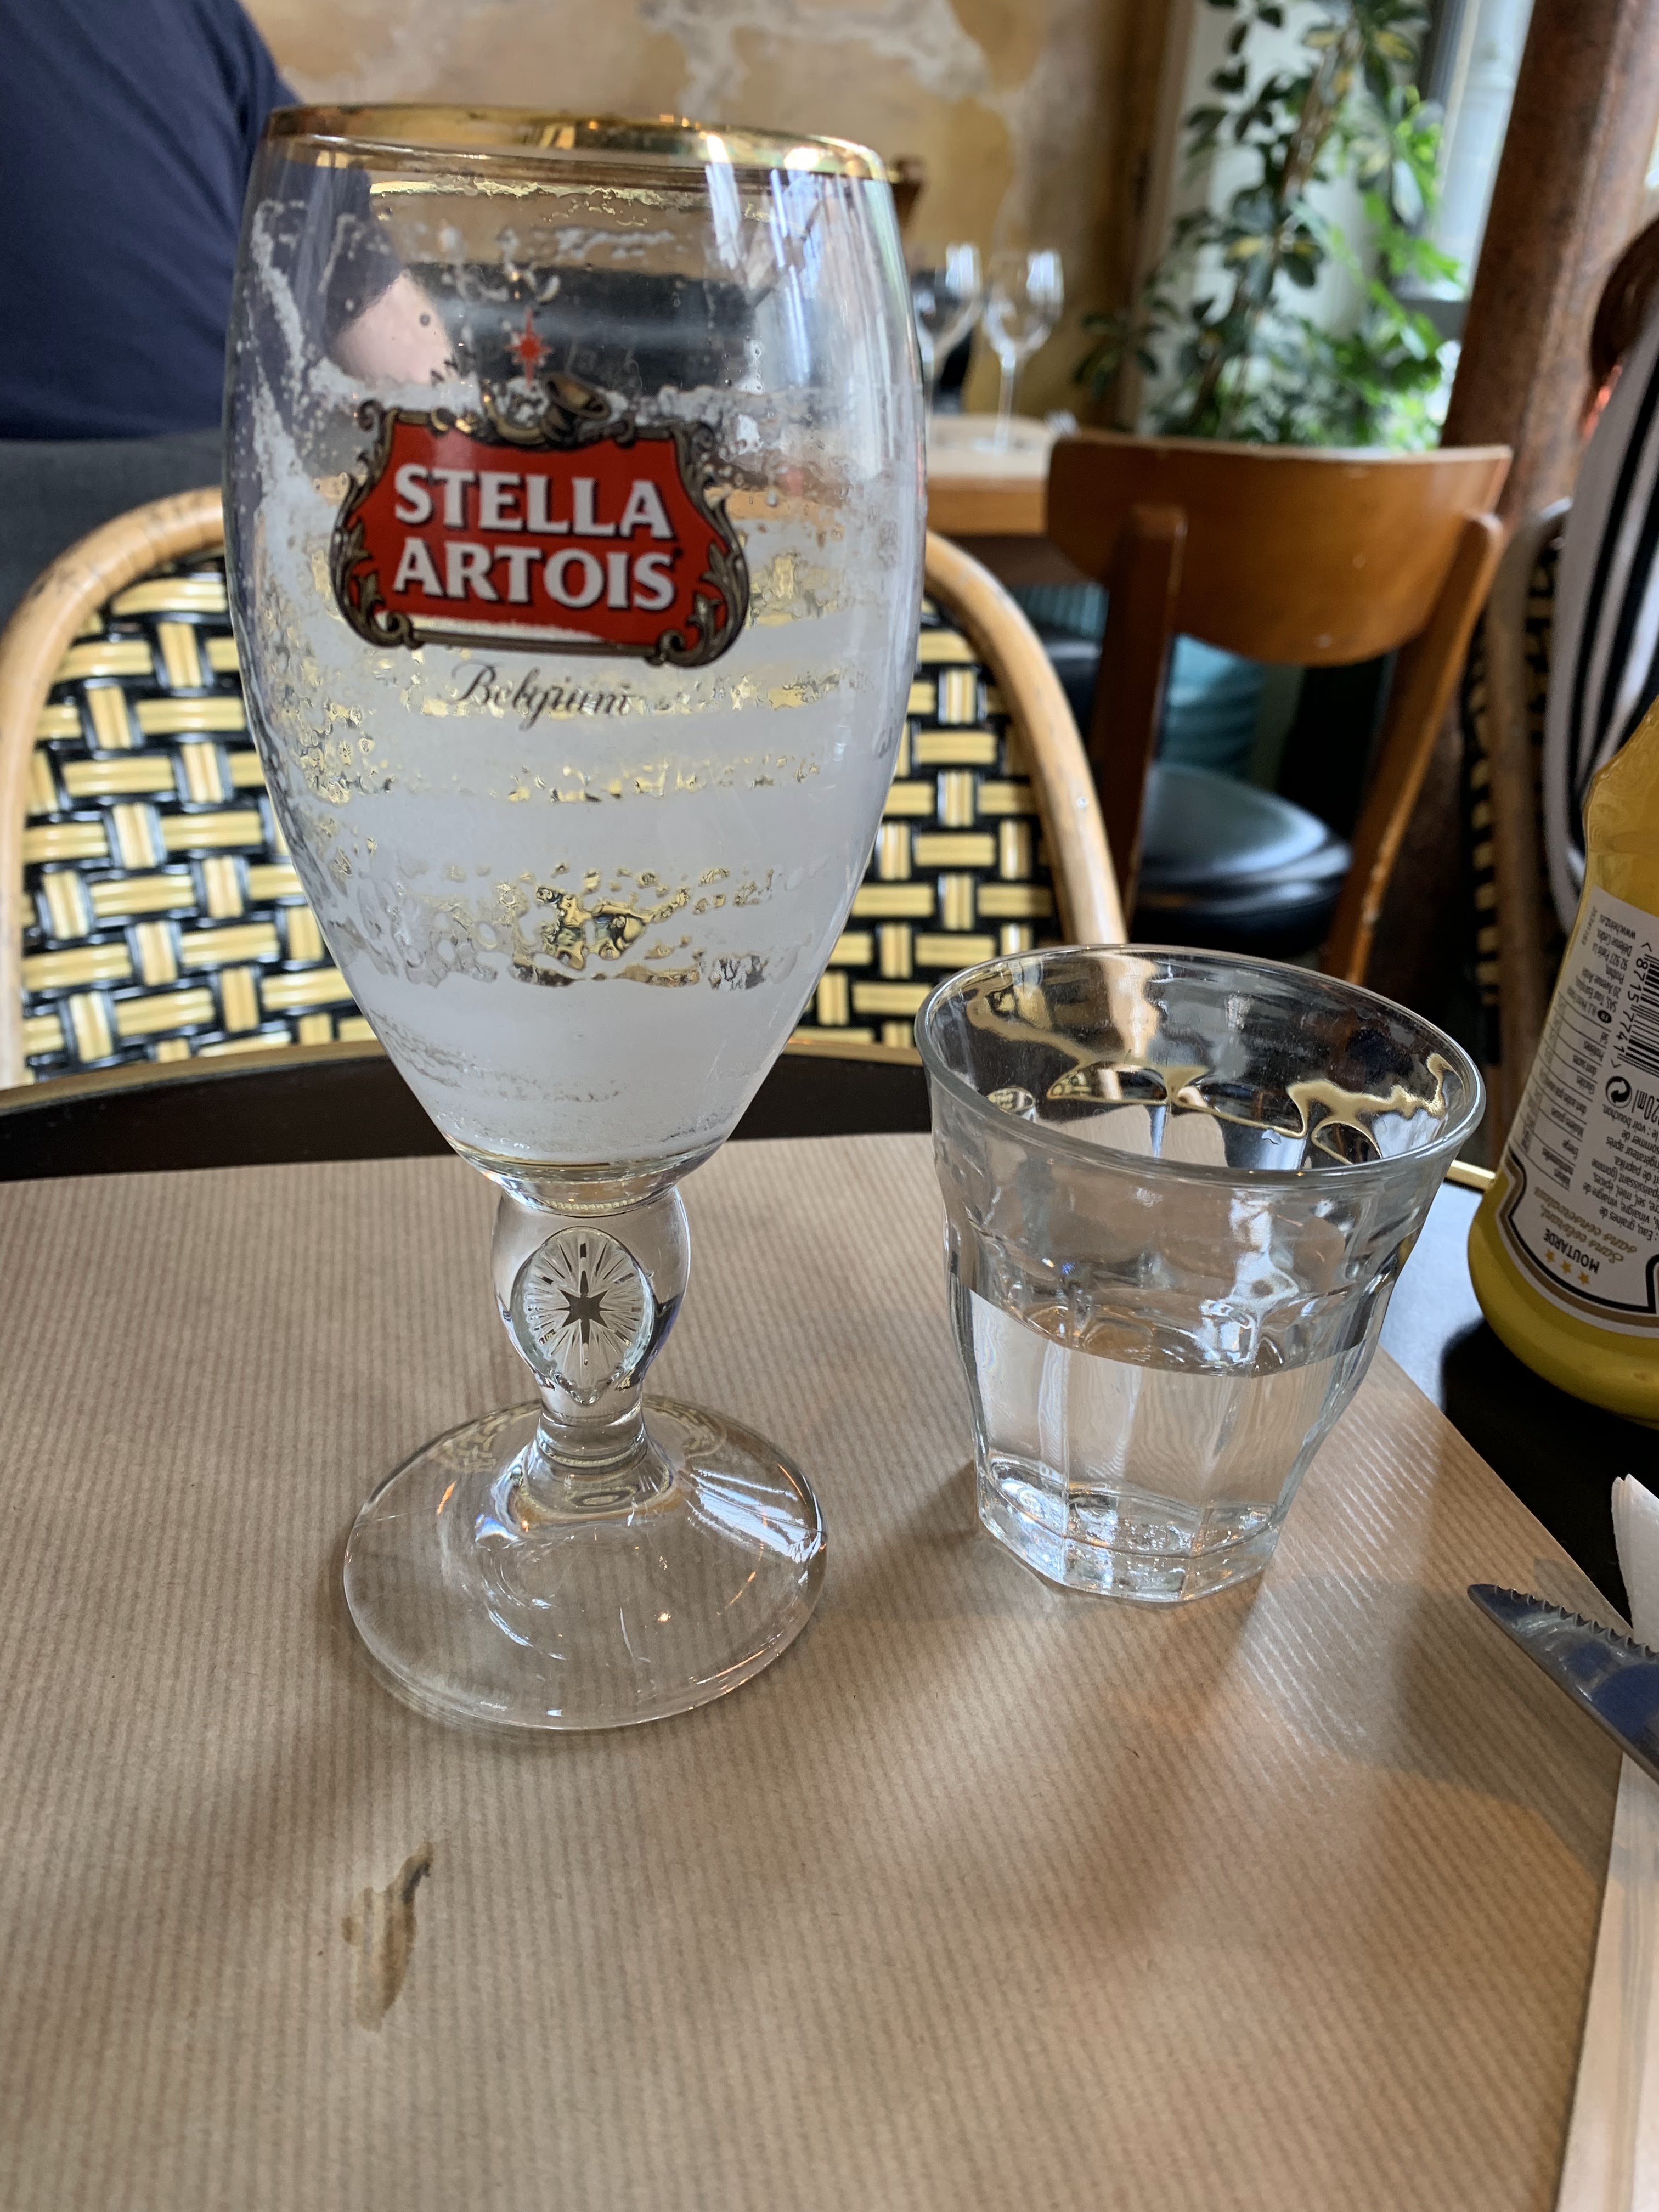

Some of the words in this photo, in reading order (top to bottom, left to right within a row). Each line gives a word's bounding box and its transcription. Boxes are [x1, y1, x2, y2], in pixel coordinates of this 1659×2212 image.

[395, 463, 674, 539] STELLA
[392, 537, 677, 611] ARTOIS
[452, 660, 631, 731] Belgium
[1631, 1089, 1658, 1124] 20ml
[1621, 1130, 1630, 1142] de
[1582, 1182, 1591, 1194] de
[1618, 1172, 1658, 1199] paississant
[1641, 1170, 1652, 1183] de
[1598, 1205, 1609, 1219] de
[1601, 1232, 1638, 1256] sans
[1637, 1223, 1654, 1242] Eau,
[1542, 1227, 1600, 1274] MOUTARDE
[1586, 1238, 1624, 1265] Sans
